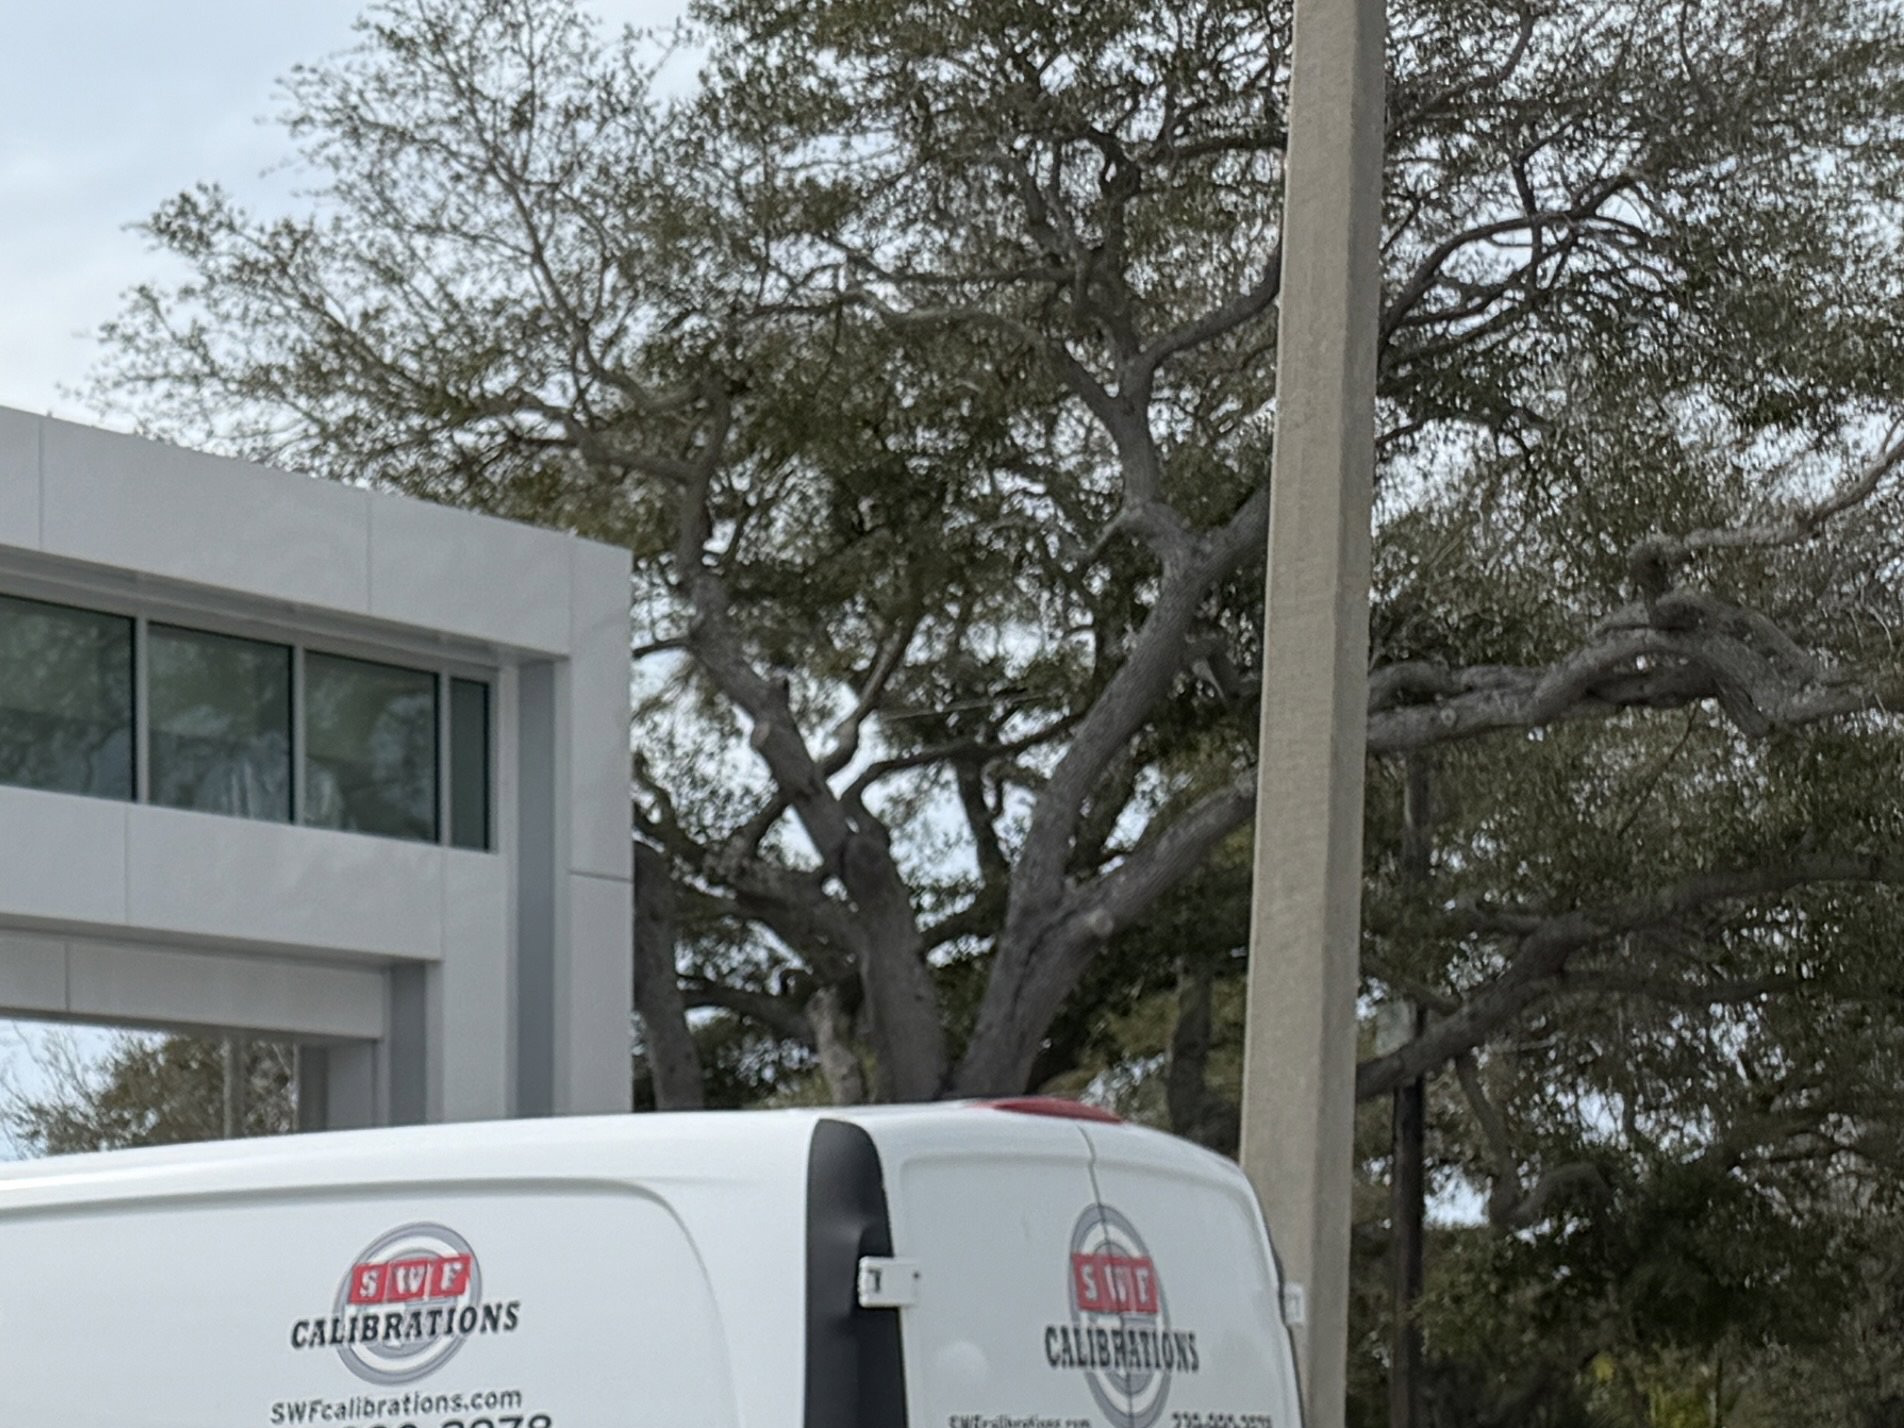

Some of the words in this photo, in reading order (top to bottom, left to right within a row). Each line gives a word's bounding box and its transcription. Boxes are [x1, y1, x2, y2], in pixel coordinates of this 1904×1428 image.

[359, 1262, 464, 1298] SWF
[1080, 1264, 1151, 1306] SWF
[291, 1300, 521, 1350] CALIBRATIONS
[1043, 1324, 1200, 1374] CALIBRATIONS
[270, 1390, 523, 1425] SWFcalibrations.com
